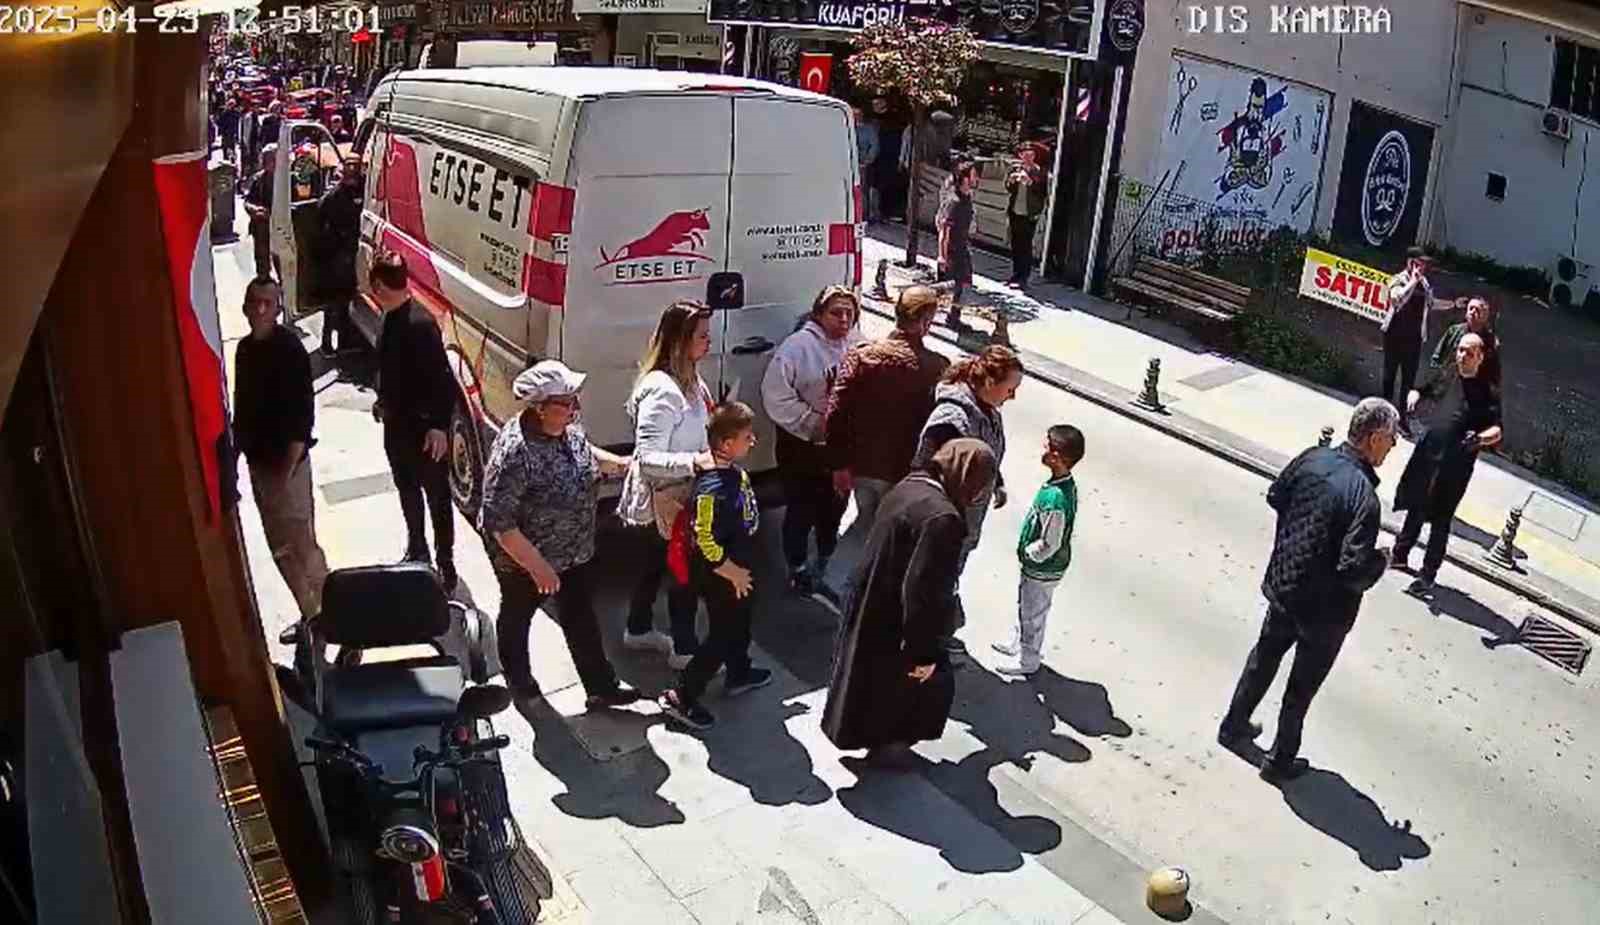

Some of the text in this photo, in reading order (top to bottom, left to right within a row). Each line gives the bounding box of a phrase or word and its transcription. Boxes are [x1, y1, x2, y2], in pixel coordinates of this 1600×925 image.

[430, 152, 530, 228] ETSE ET
[615, 259, 697, 279] ETSE ET
